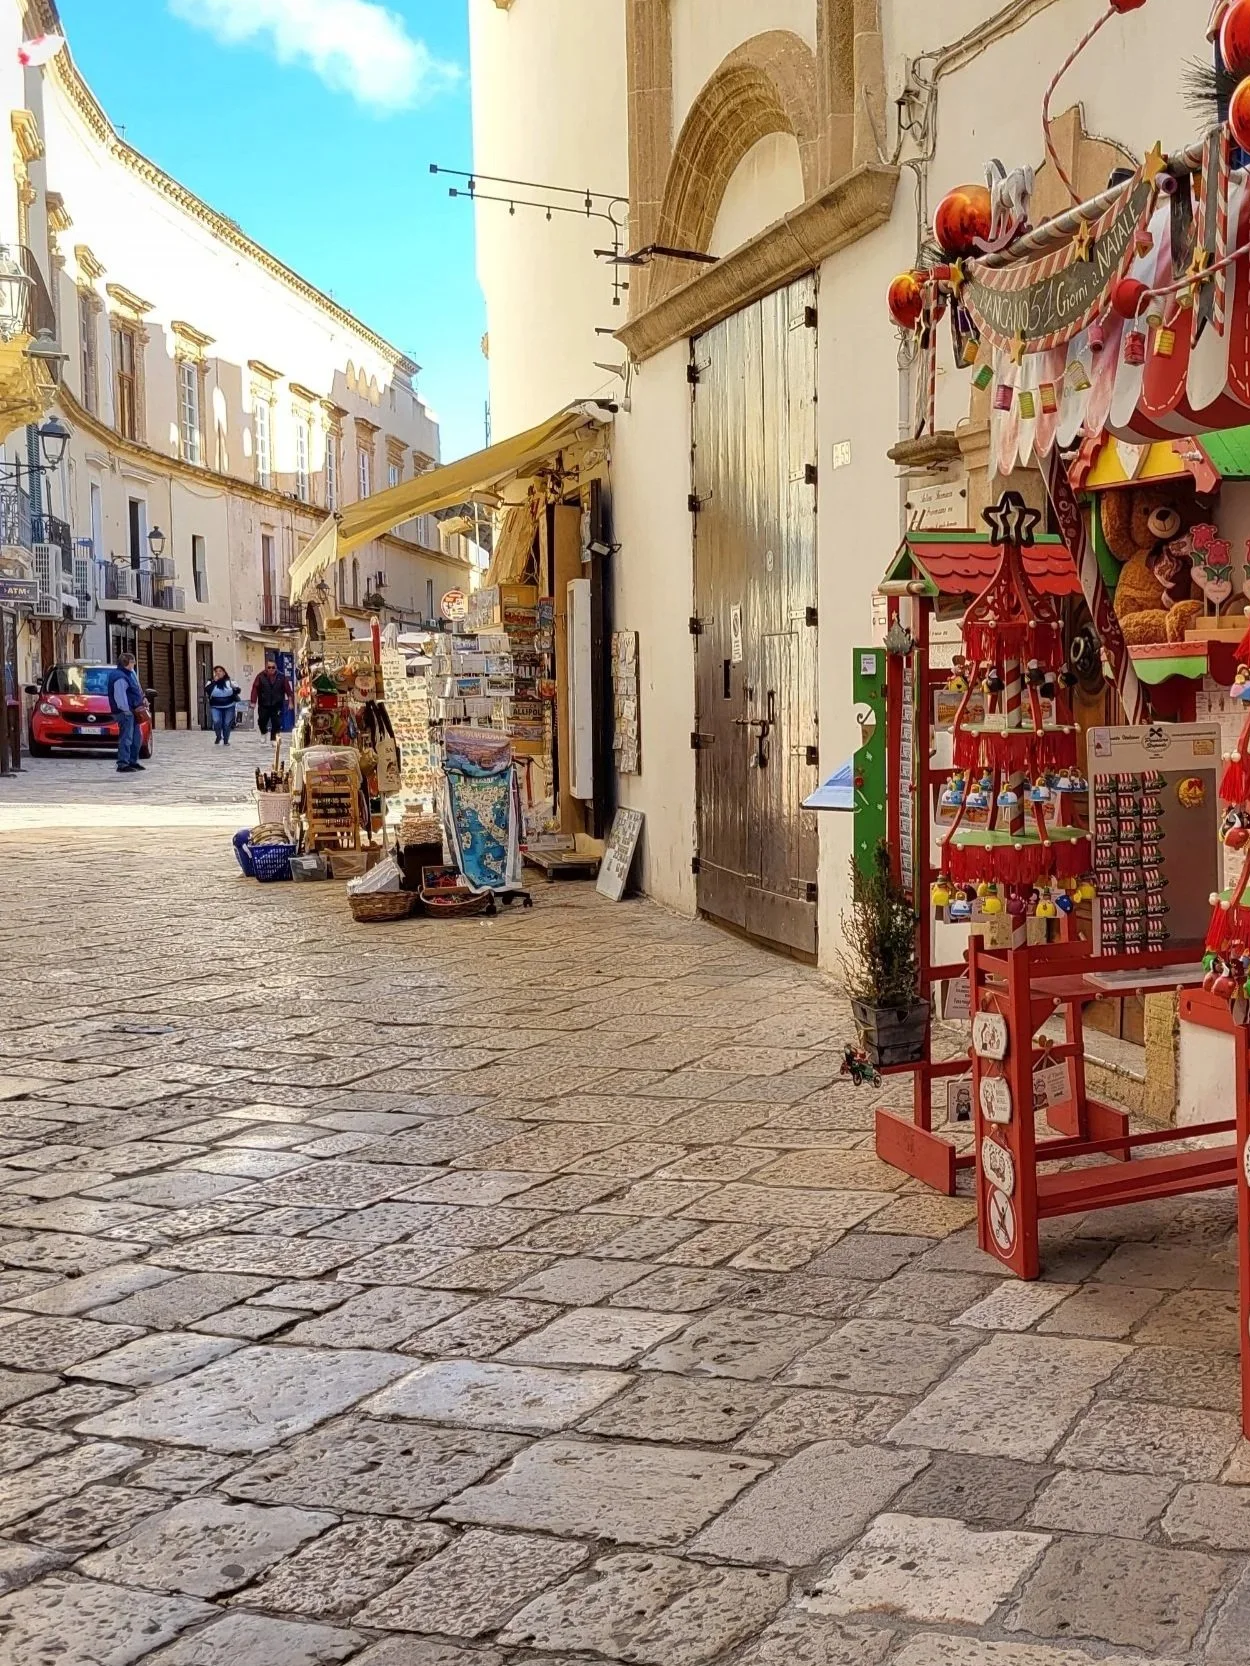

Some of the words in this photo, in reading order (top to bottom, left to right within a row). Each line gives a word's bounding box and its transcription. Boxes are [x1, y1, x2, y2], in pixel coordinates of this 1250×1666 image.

[1055, 280, 1089, 318] Giorni
[1096, 200, 1140, 278] NATALE
[7, 587, 27, 595] ATM
